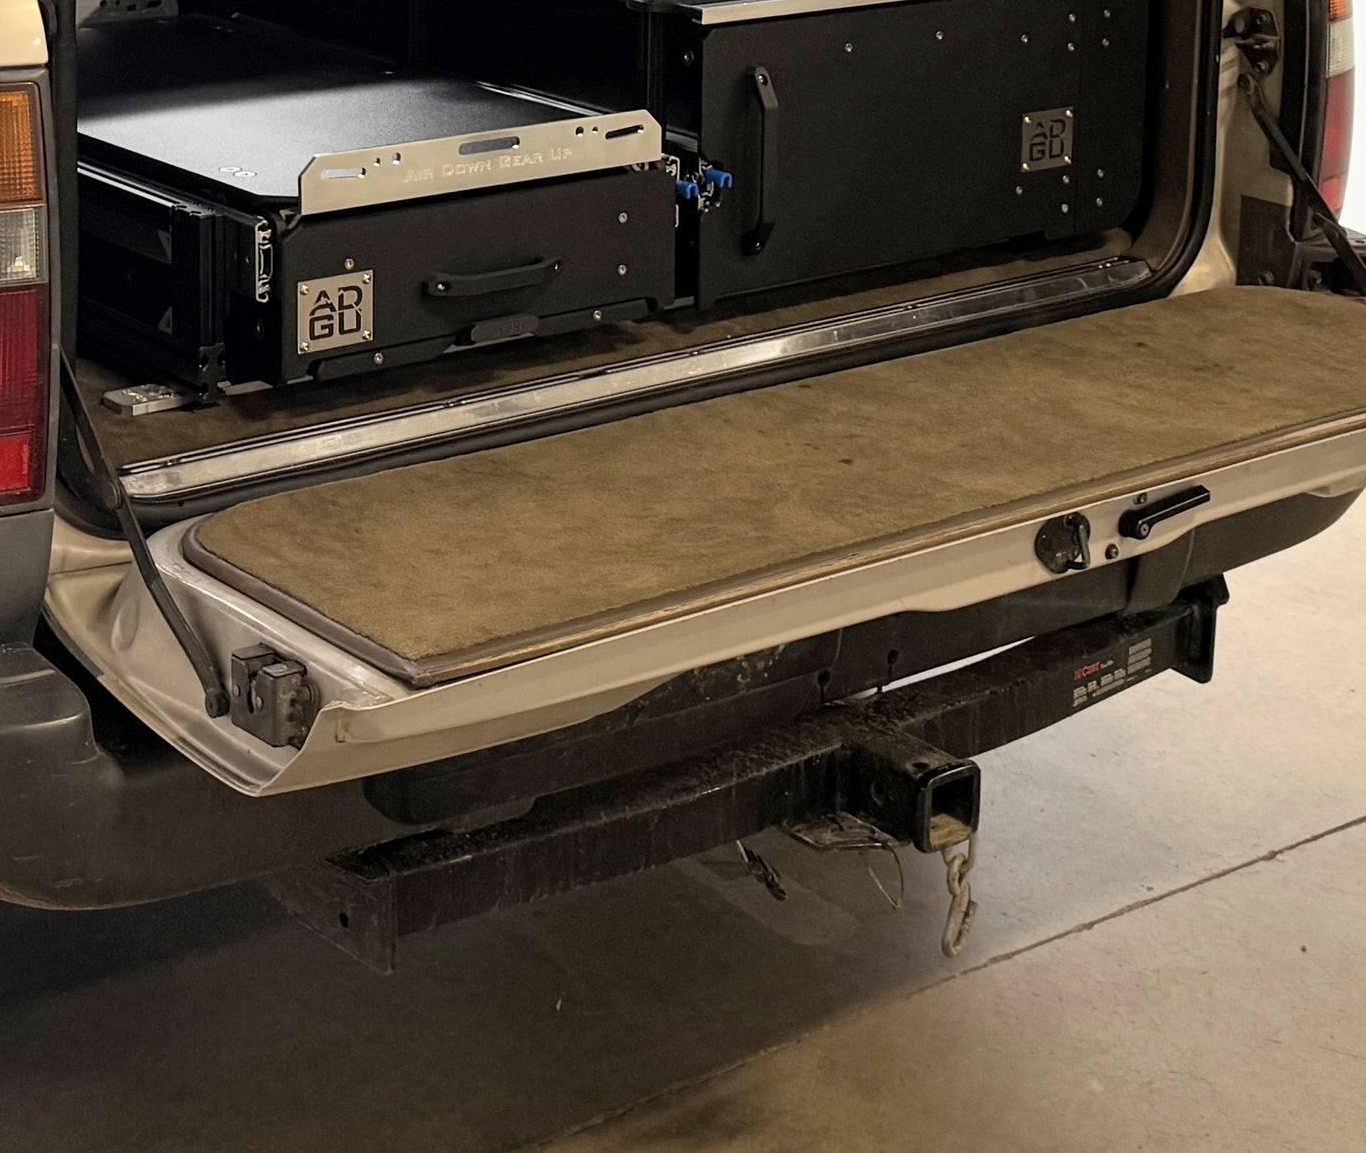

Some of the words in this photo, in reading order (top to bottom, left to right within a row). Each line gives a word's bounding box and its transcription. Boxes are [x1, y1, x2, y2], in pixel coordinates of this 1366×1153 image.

[403, 168, 434, 183] AIR
[441, 159, 492, 178] DOWN
[498, 152, 544, 168] GEAR
[550, 147, 573, 161] UP
[309, 285, 363, 316] AD
[309, 310, 362, 341] GU
